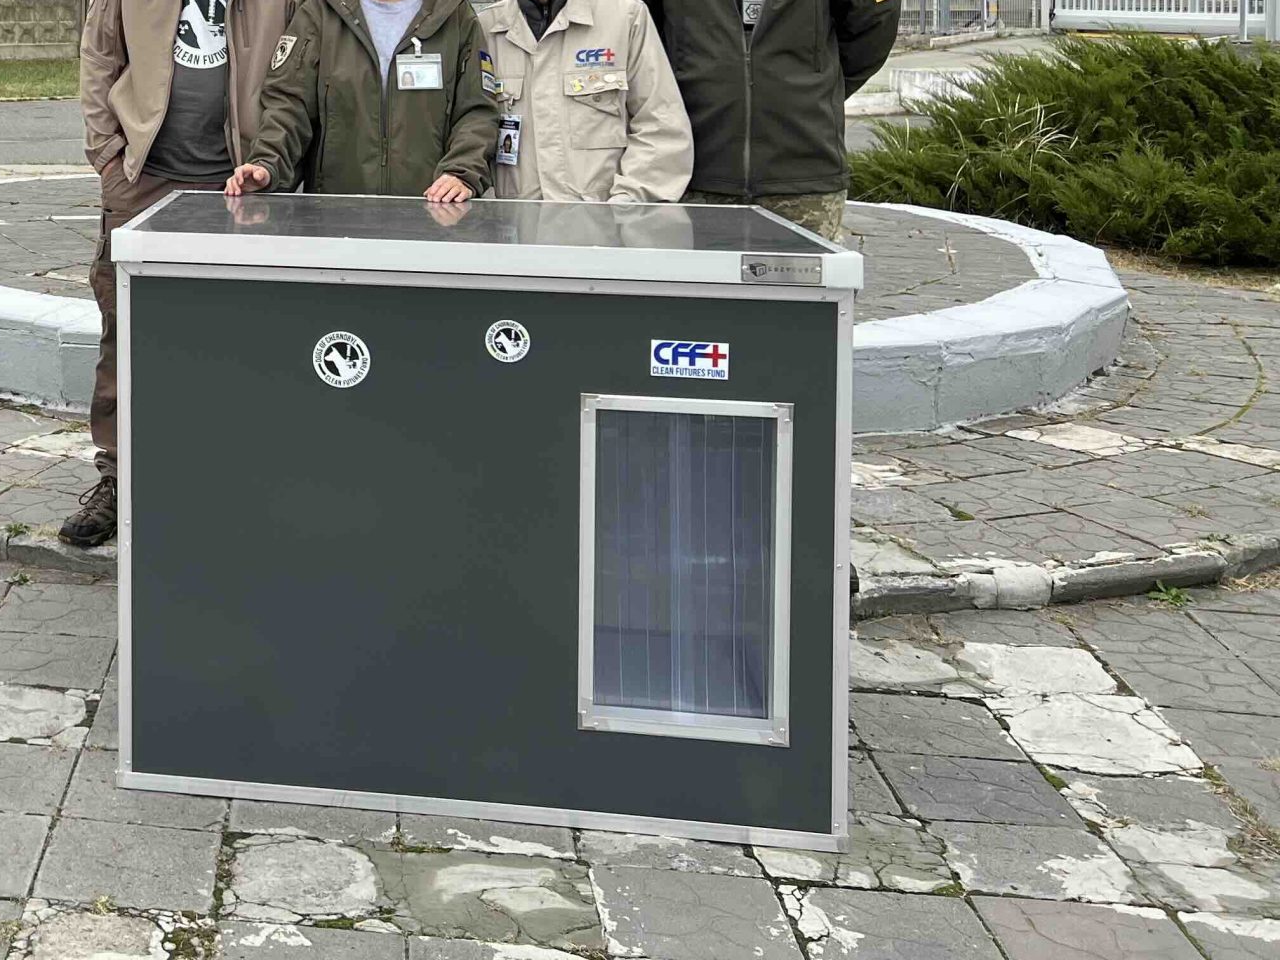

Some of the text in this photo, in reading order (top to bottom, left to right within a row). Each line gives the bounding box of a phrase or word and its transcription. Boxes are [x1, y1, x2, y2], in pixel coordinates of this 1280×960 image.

[174, 45, 200, 65] CLEAN
[319, 340, 326, 348] OF
[324, 374, 342, 386] CLEAN
[360, 357, 368, 372] FUND
[652, 366, 726, 378] CLEAN FUTURES FUND
